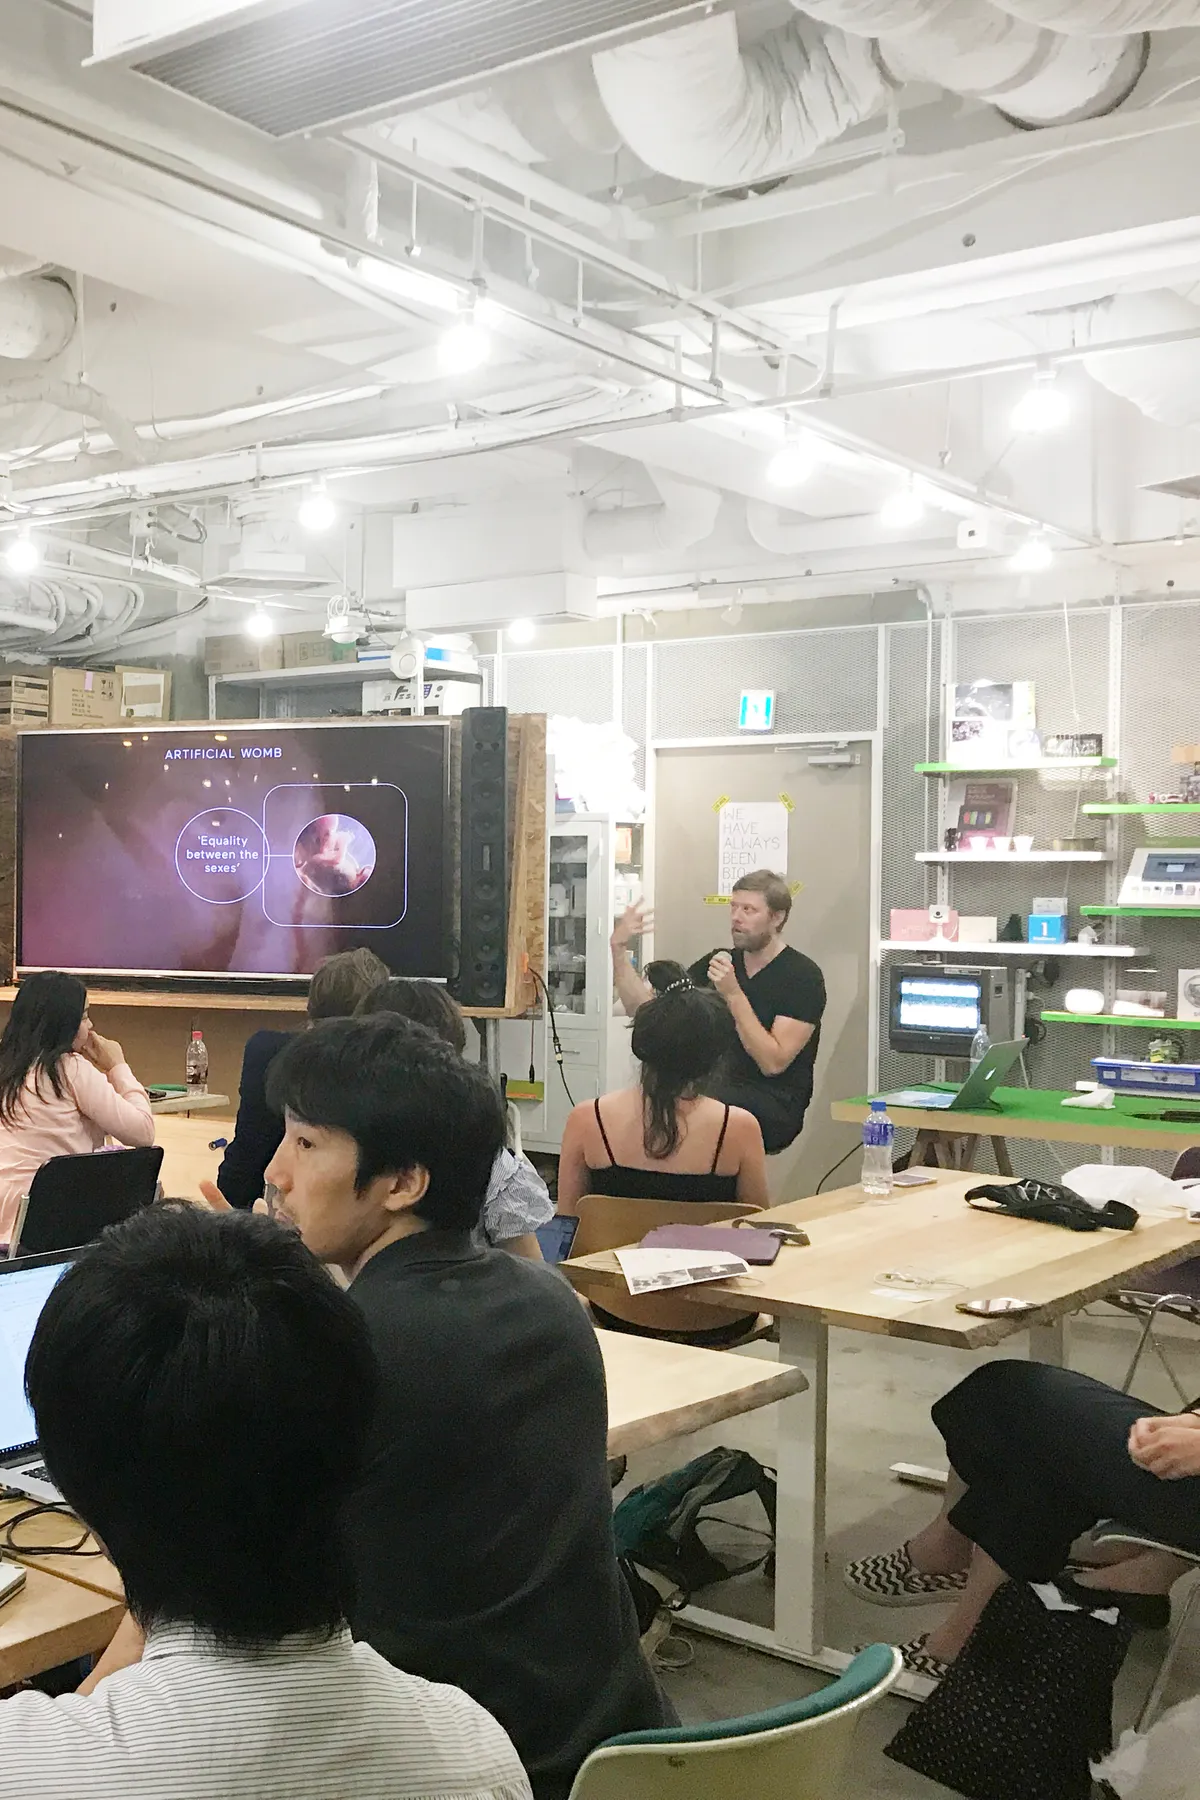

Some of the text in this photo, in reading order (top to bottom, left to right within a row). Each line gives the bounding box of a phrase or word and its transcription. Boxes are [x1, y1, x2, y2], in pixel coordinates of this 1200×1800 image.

[164, 747, 283, 760] ARTIFICIAL WOMB
[723, 807, 745, 820] WE
[722, 821, 759, 835] HAVE
[723, 836, 781, 850] ALWAYS
[186, 849, 259, 860] between the
[722, 851, 757, 865] BEEN
